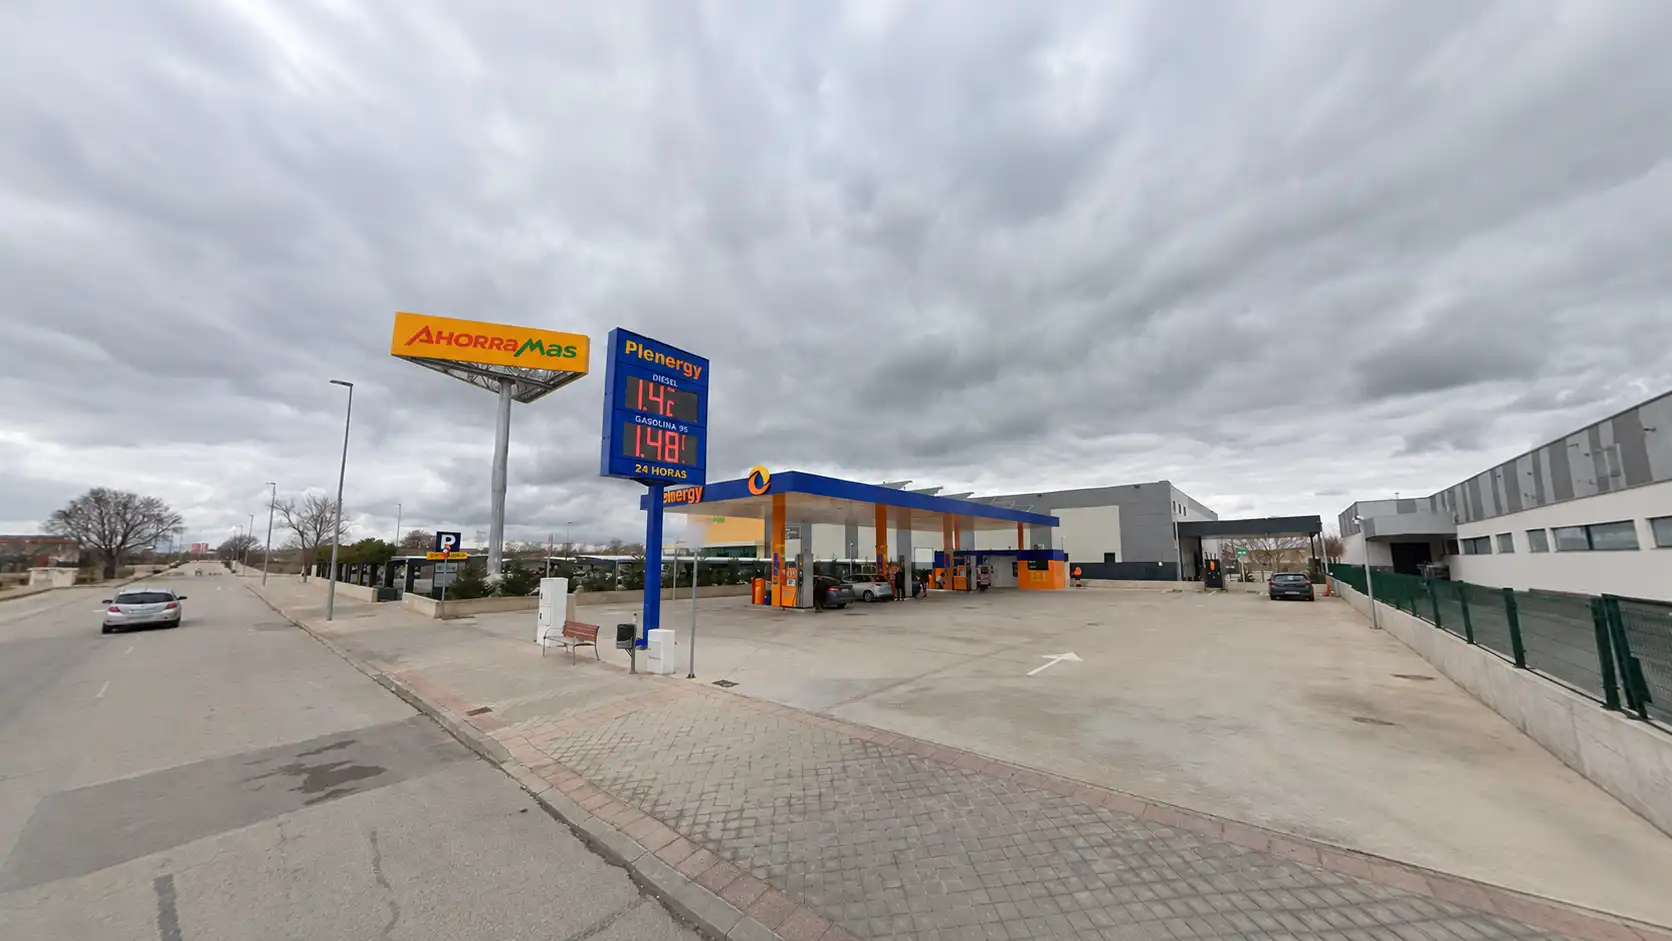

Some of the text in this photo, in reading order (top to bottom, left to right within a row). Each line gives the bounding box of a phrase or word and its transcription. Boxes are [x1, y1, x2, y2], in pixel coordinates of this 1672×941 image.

[625, 340, 703, 380] Plenergy
[652, 373, 678, 387] DIESEL
[635, 415, 689, 433] GASOLINA 95
[635, 463, 688, 479] 24 HORAS
[440, 534, 456, 550] P
